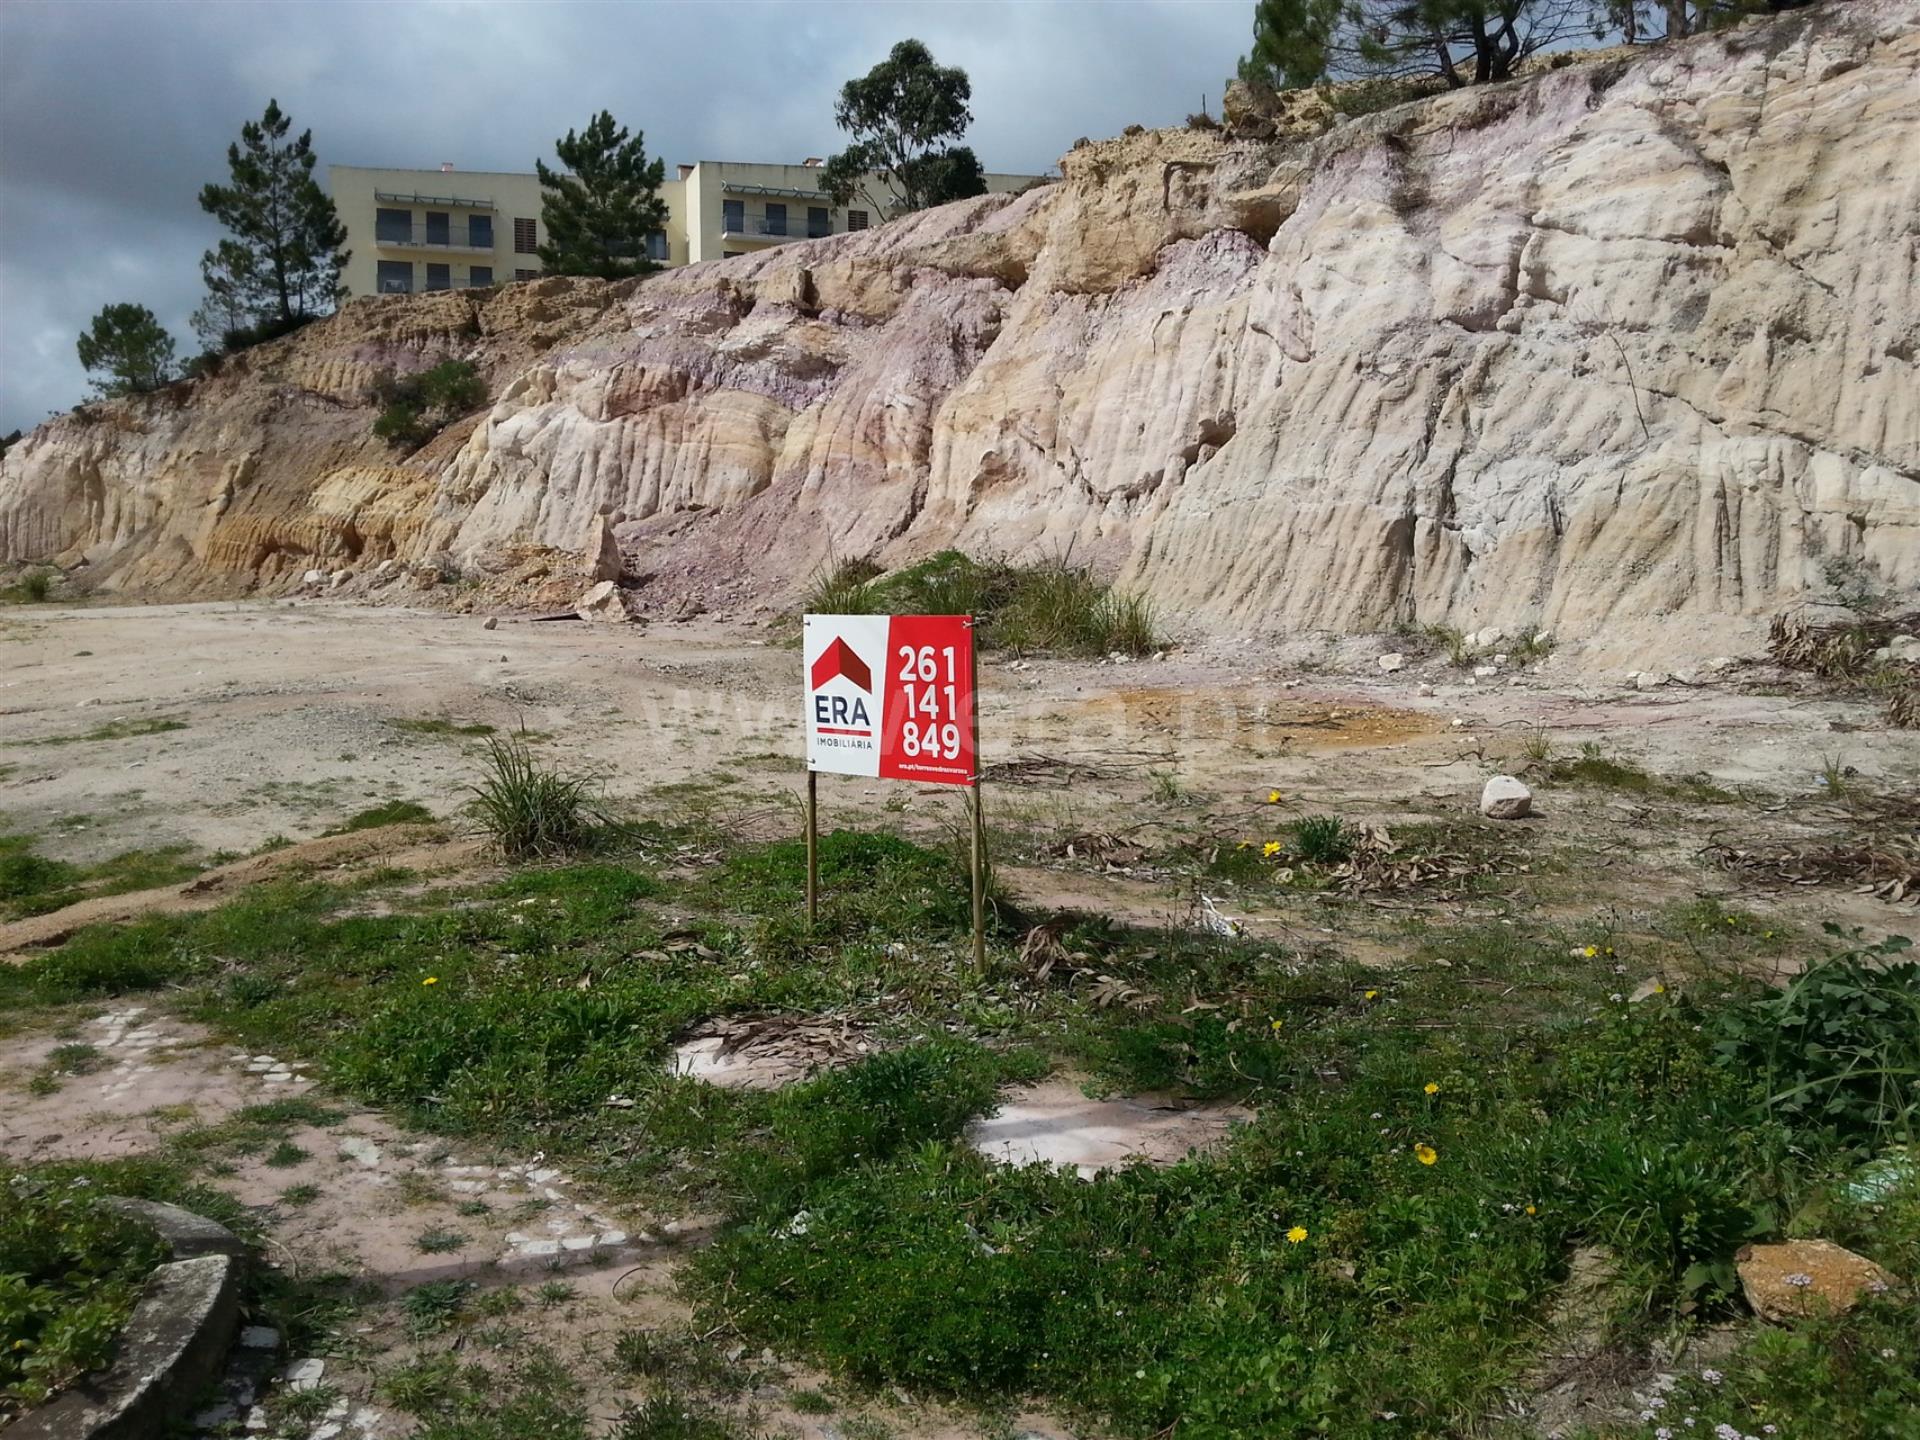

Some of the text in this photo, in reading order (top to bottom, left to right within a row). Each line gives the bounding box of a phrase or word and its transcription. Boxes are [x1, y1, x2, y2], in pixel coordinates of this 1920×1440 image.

[899, 645, 955, 683] 261
[815, 695, 870, 726] ERA
[903, 683, 956, 721] 141
[817, 737, 873, 750] IMOBILIÁRIA
[902, 721, 960, 760] 849
